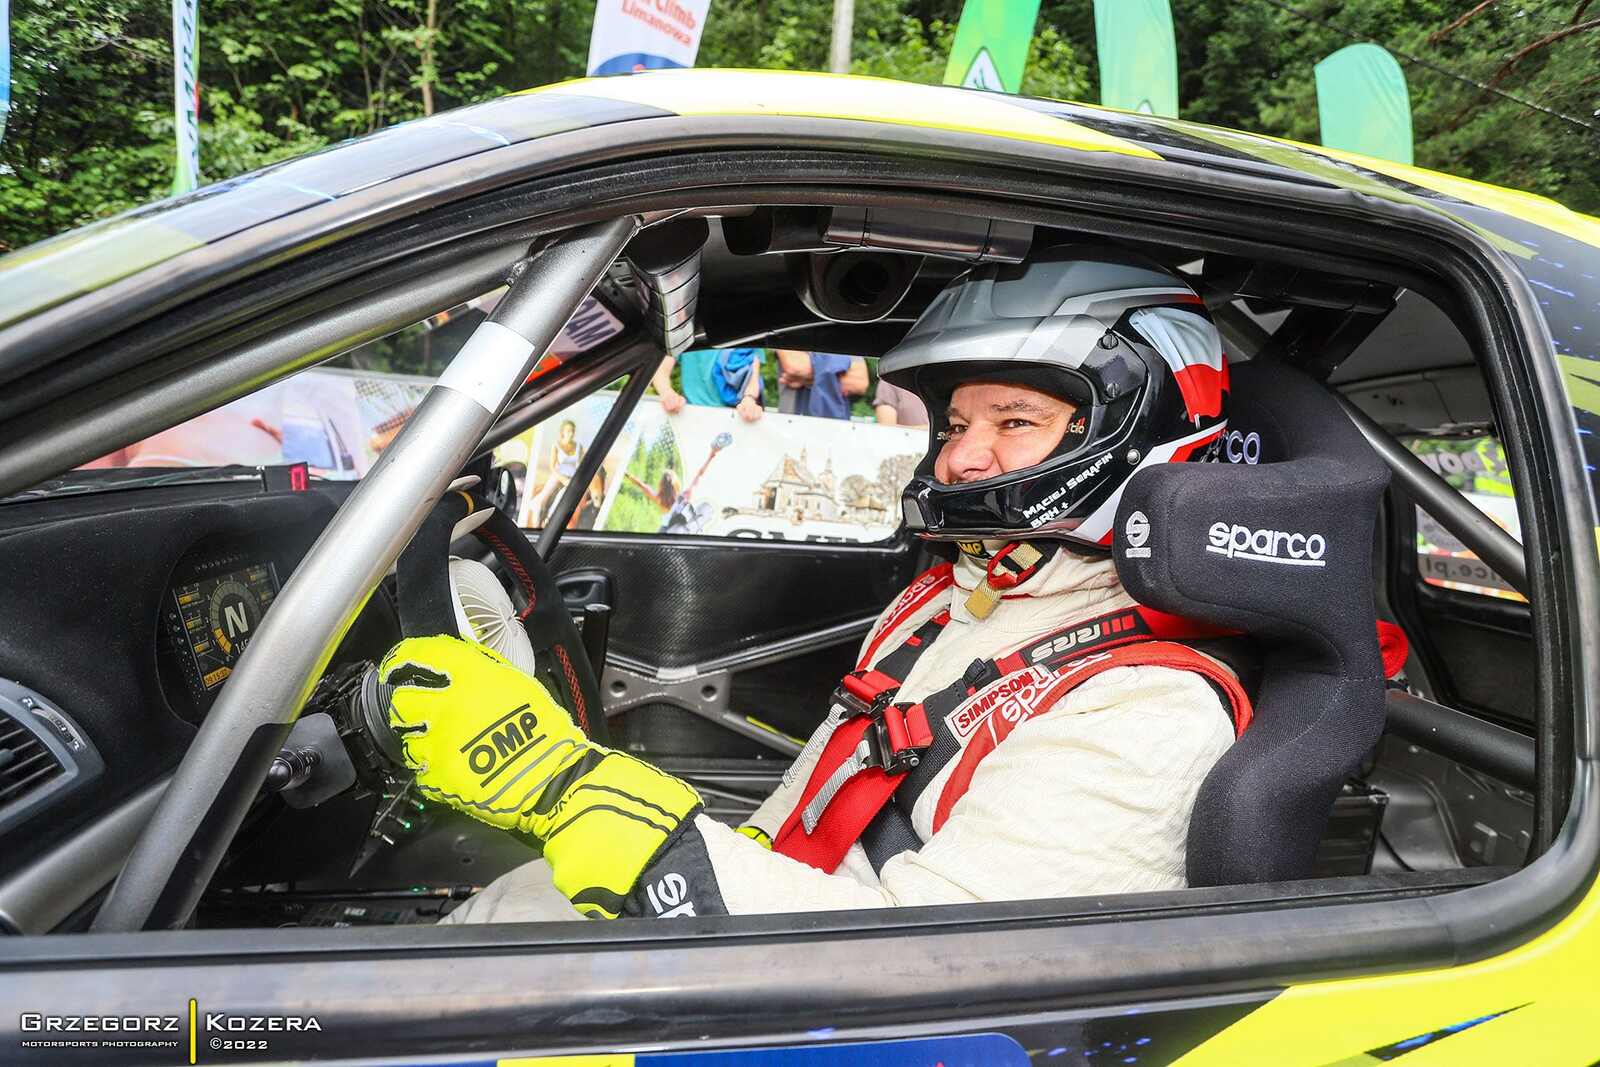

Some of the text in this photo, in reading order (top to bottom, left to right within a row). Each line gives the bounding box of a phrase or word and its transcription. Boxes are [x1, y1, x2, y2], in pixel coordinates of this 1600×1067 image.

[622, 0, 691, 44] Limanowa
[1022, 452, 1114, 519] MACIEJ SERAFIN
[1029, 507, 1060, 529] BRH
[1207, 521, 1326, 561] sparco
[224, 601, 249, 638] N
[958, 671, 1035, 729] SIMPSON
[469, 712, 538, 775] OMP
